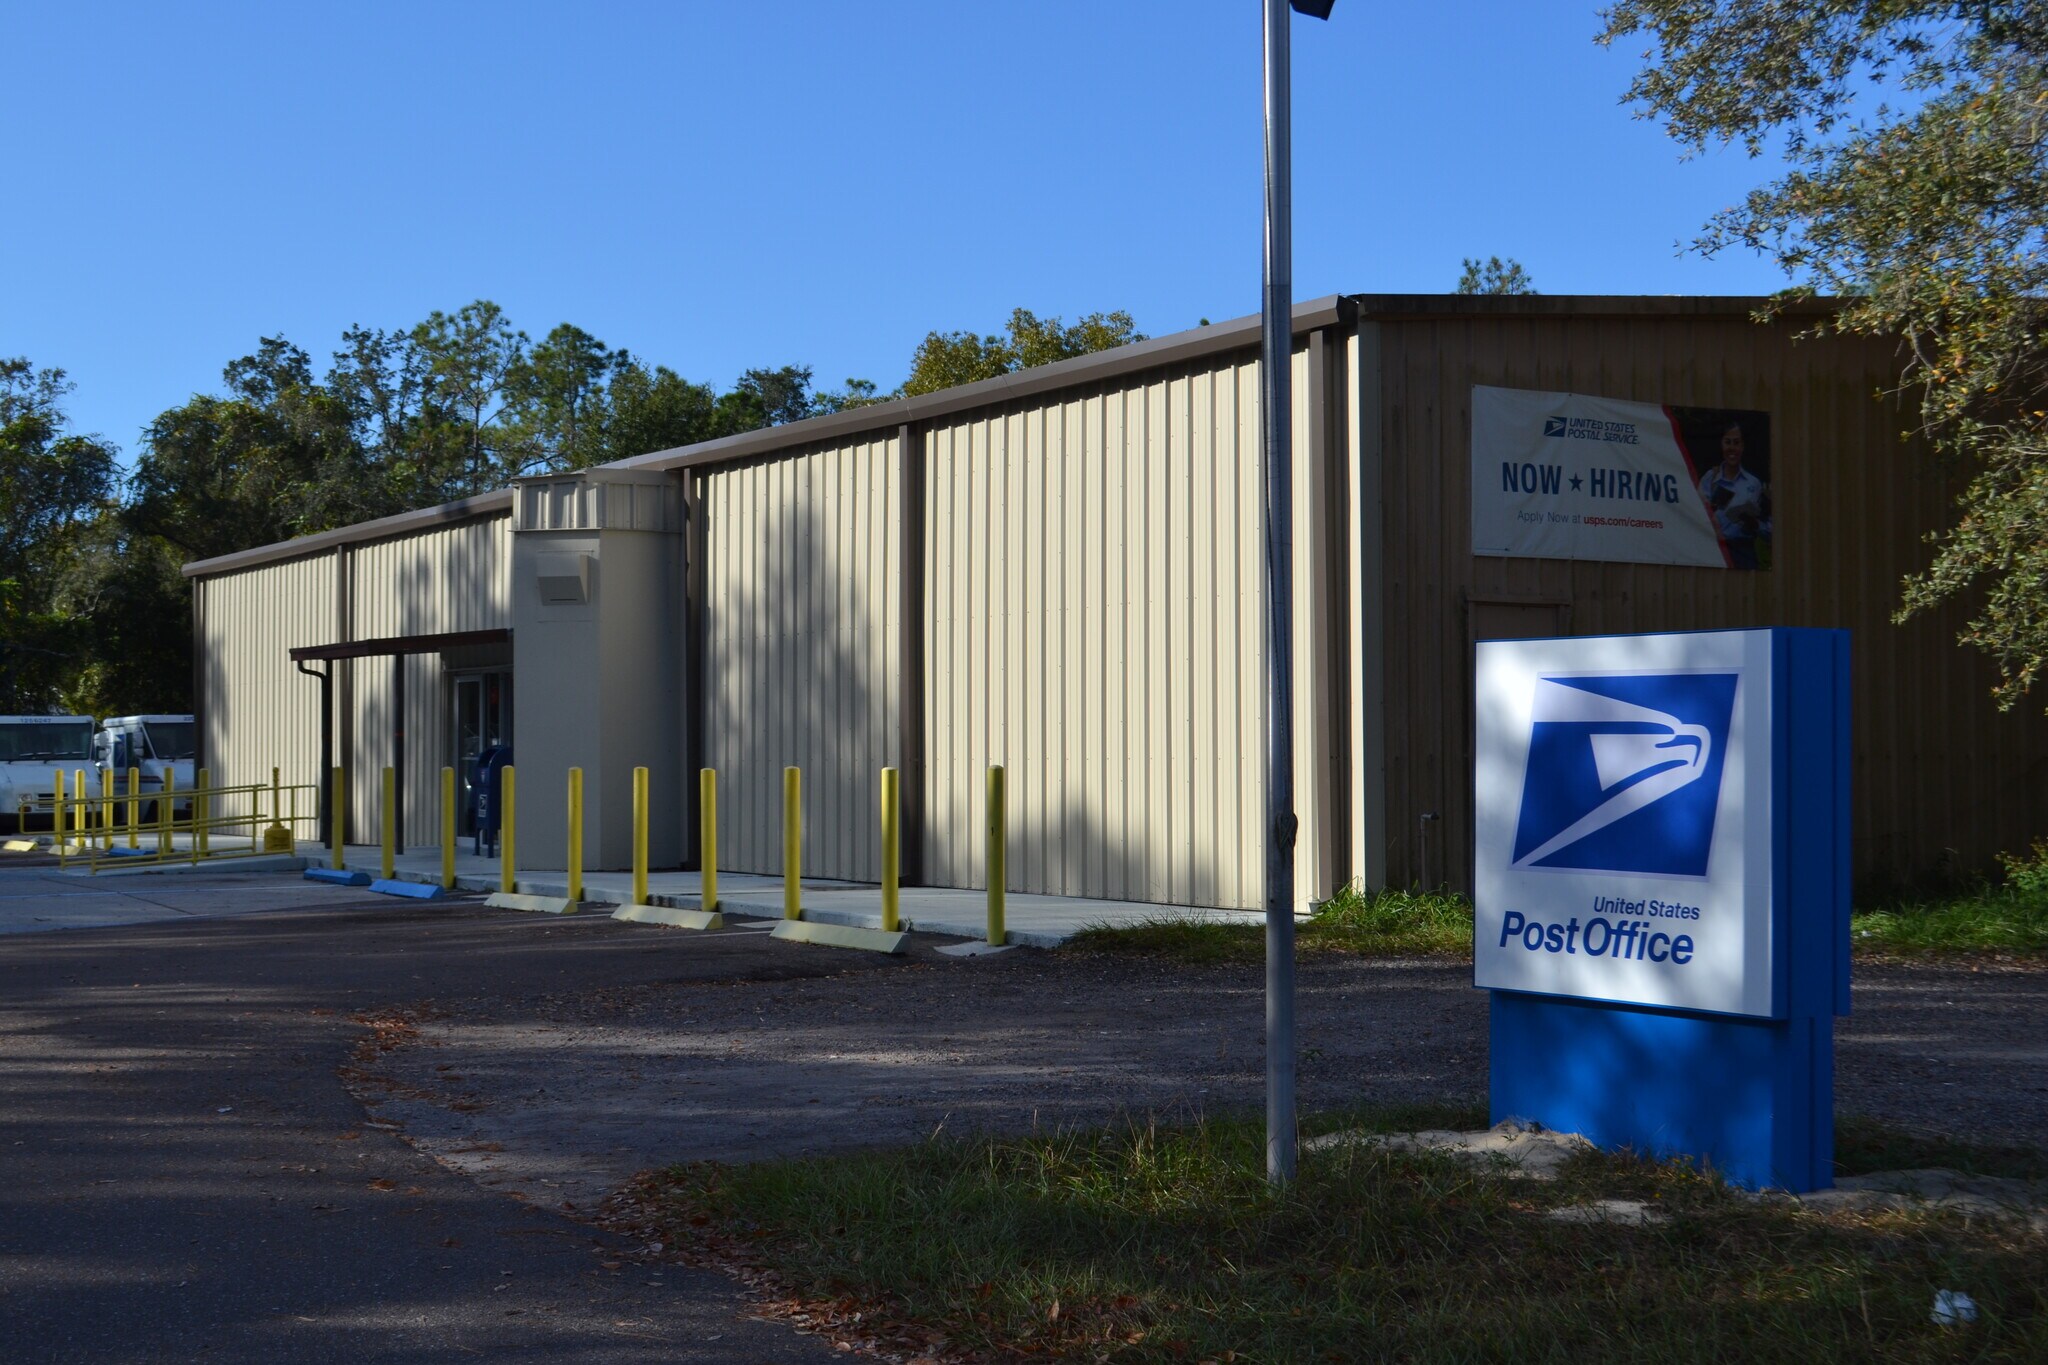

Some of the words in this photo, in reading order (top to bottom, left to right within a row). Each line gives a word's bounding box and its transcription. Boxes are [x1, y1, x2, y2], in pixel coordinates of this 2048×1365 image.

[1569, 417, 1603, 429] UNITED
[1605, 421, 1636, 433] STATES
[1567, 428, 1601, 441] POSTAL
[1603, 432, 1640, 445] SERVICE
[1502, 462, 1562, 495] NOW
[1590, 468, 1680, 504] HIRING
[1517, 510, 1545, 524] Apply
[1547, 511, 1570, 523] Now
[1572, 513, 1581, 524] at
[1583, 516, 1664, 530] usps.com/careers
[1593, 896, 1645, 916] United
[1648, 900, 1701, 920] States
[1499, 910, 1580, 955] Post
[1583, 917, 1695, 965] Office
